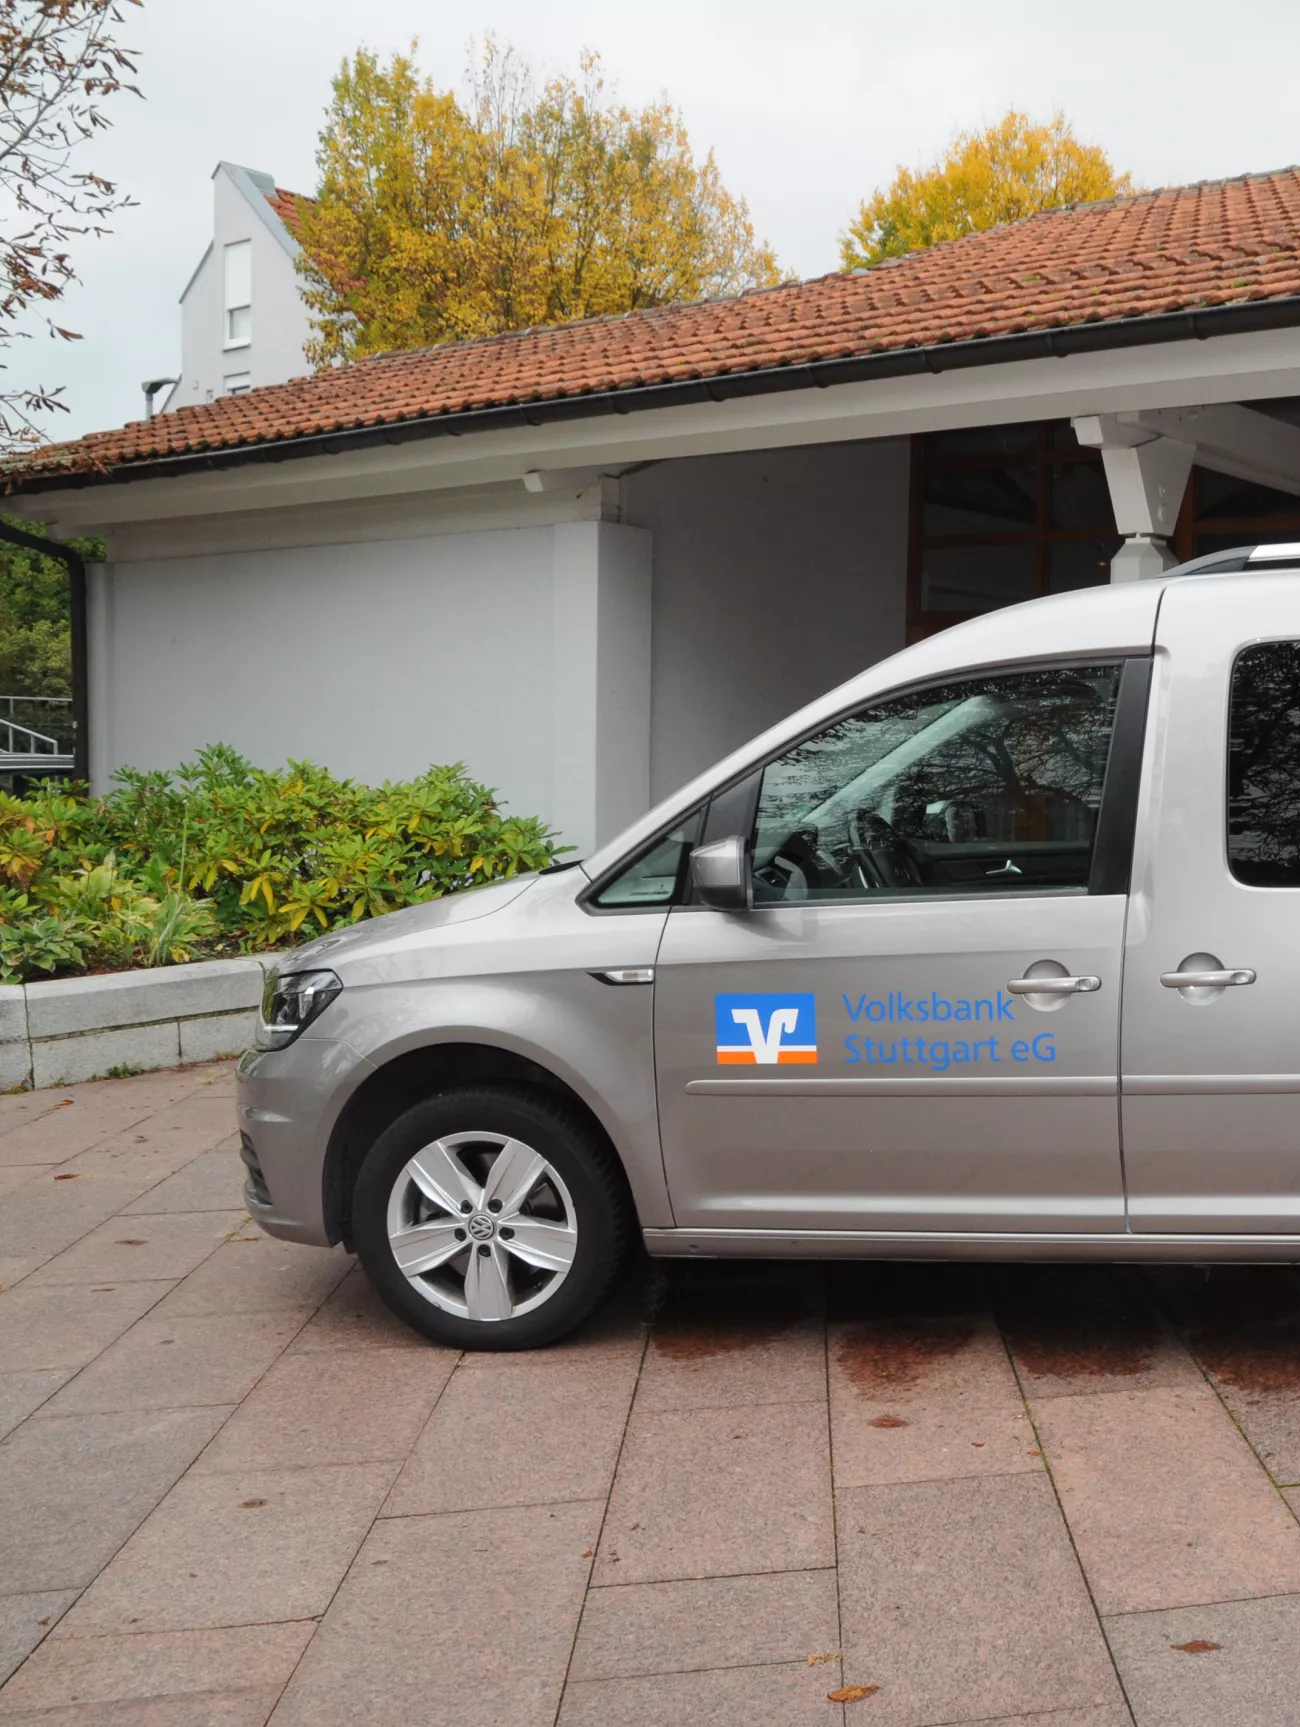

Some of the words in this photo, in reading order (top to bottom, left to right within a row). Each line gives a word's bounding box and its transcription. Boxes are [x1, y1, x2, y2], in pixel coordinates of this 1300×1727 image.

[842, 991, 1016, 1023] Volksbank
[844, 1034, 1000, 1071] Stuttgart
[1010, 1033, 1056, 1063] eG
